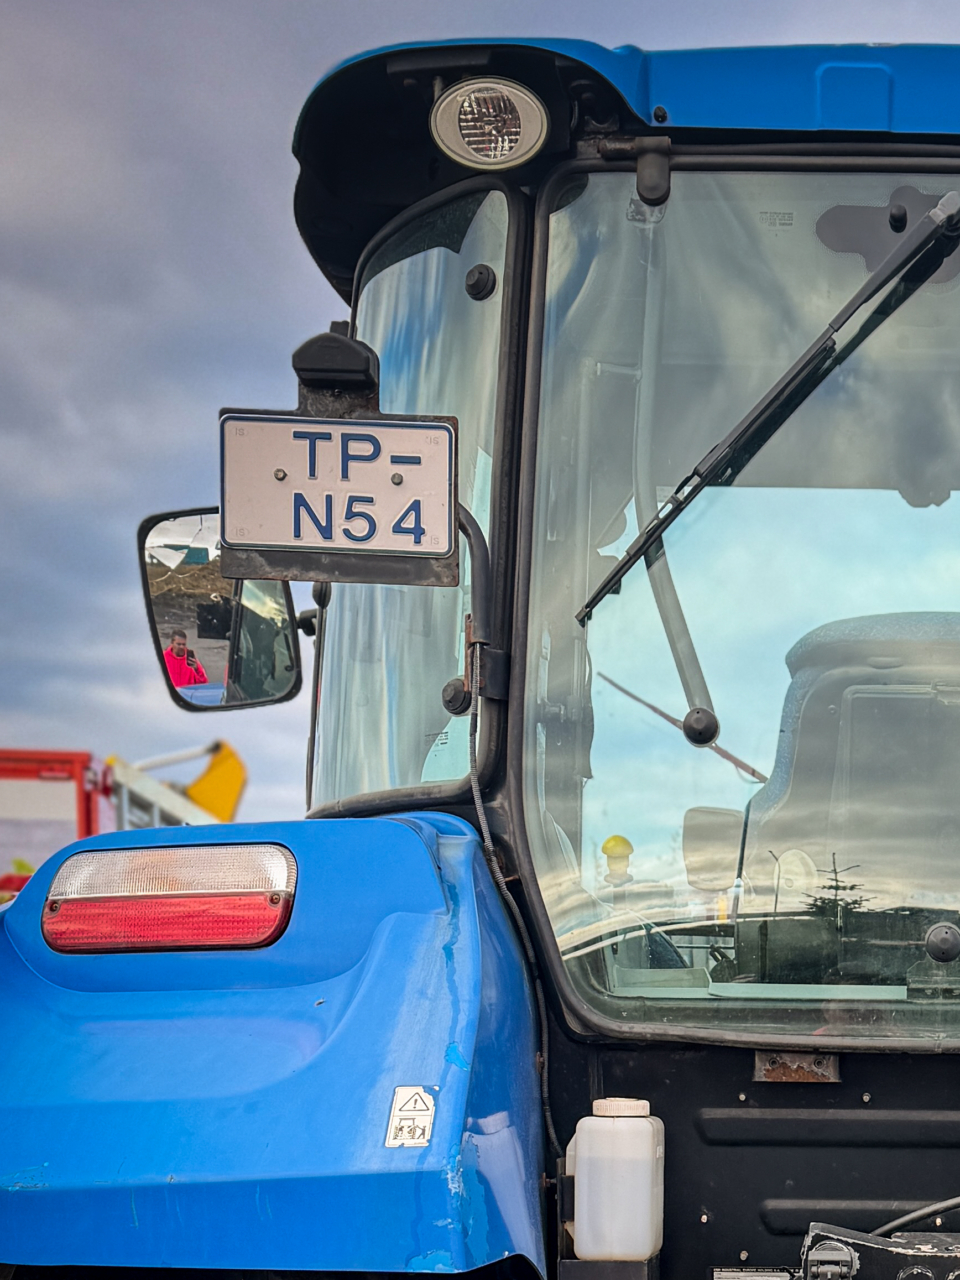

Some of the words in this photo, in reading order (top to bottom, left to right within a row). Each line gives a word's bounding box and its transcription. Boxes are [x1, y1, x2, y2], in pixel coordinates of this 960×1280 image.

[234, 428, 246, 437] IS
[292, 430, 422, 480] TP-
[234, 528, 246, 537] IS
[293, 492, 426, 545] N54
